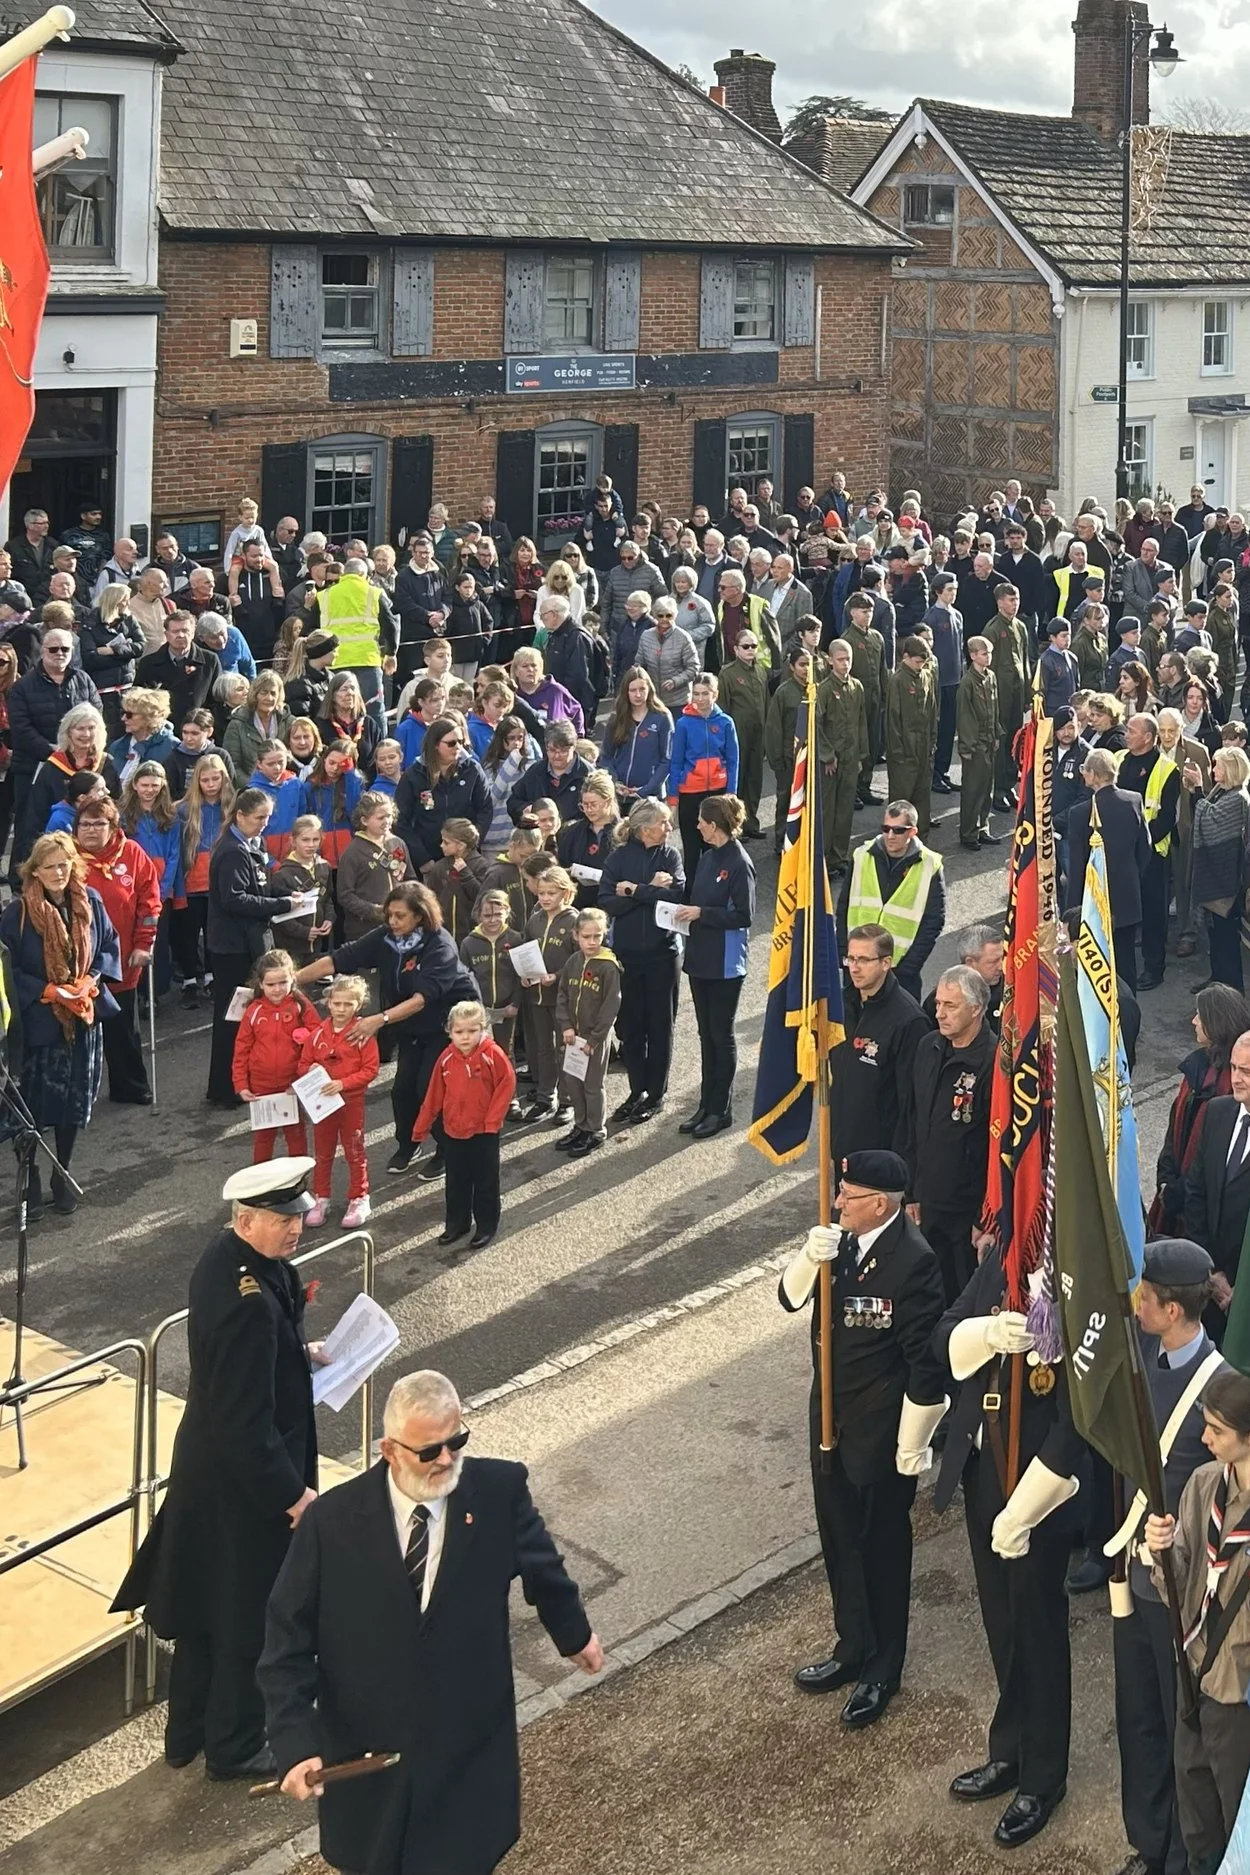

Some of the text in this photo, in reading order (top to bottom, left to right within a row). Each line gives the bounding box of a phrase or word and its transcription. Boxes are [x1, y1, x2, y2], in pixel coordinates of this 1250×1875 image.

[554, 369, 592, 377] GEORGE
[1042, 747, 1055, 922] FOUNDED 1946
